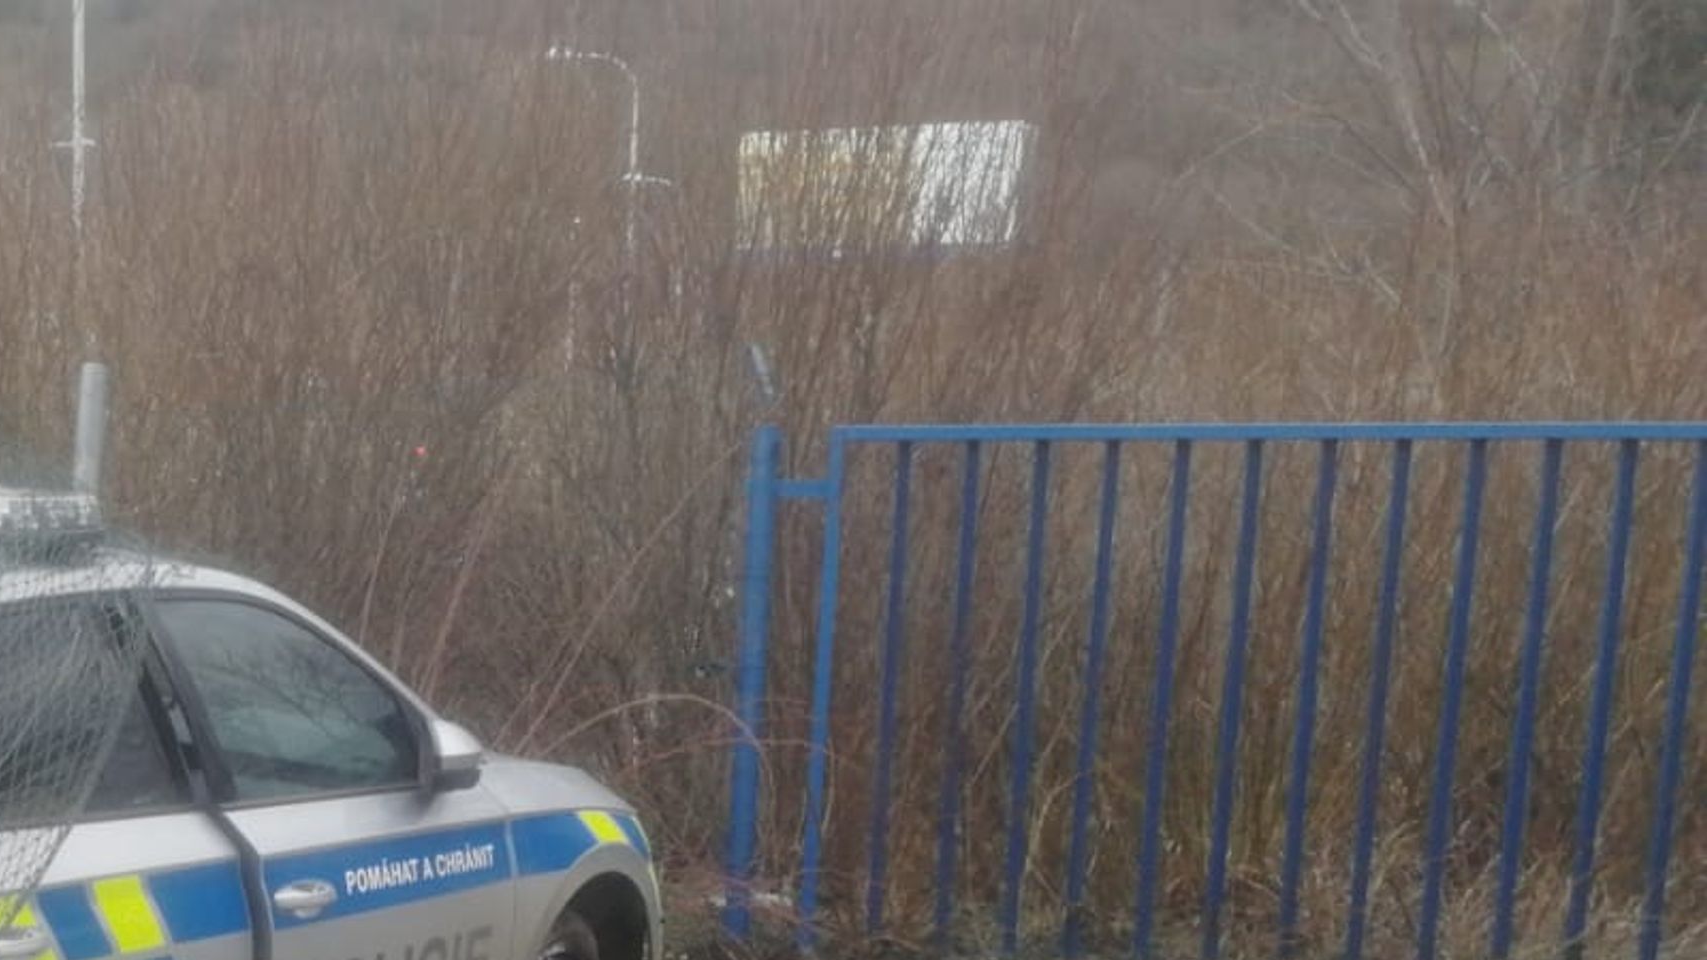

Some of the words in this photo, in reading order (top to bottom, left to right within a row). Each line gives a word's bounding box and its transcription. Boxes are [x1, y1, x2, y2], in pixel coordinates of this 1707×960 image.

[345, 857, 419, 896] POMÁHAT
[423, 857, 435, 881] A
[435, 843, 495, 876] CHRÁNIT
